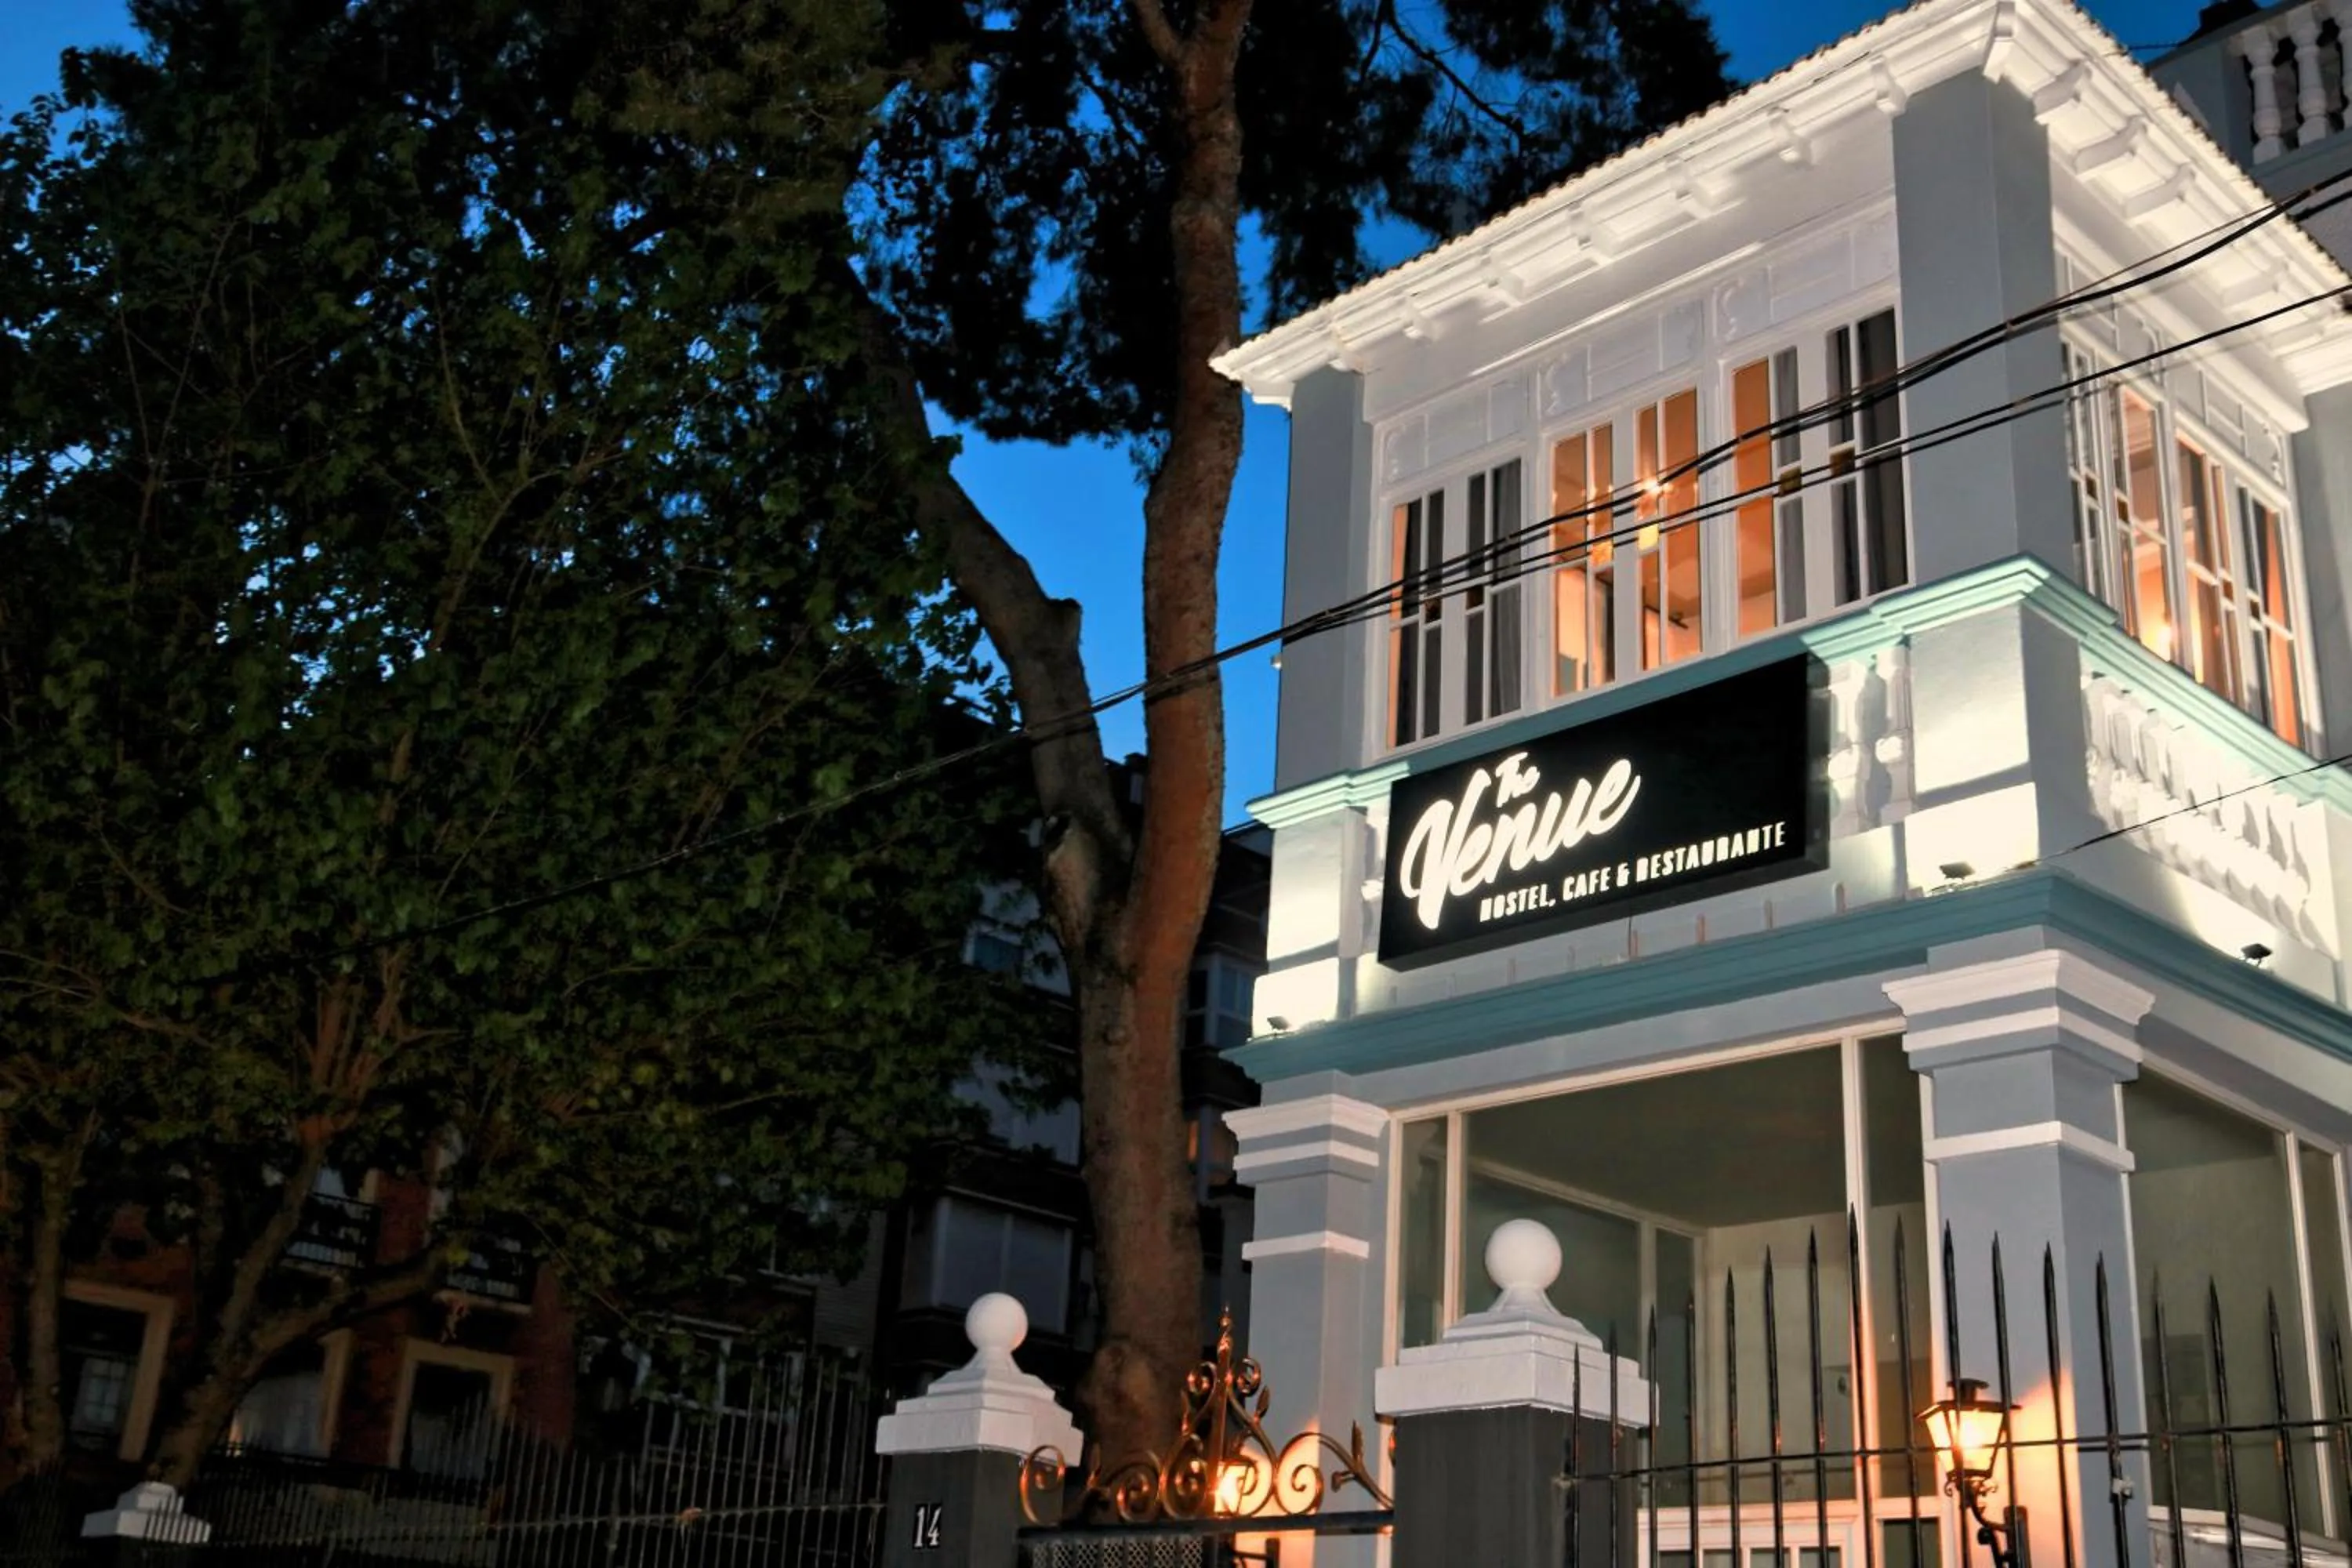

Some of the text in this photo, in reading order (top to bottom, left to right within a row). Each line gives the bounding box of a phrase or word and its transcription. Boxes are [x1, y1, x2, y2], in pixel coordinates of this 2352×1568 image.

[1494, 750, 1541, 808] The
[1399, 757, 1641, 931] Venue
[1563, 867, 1610, 902] CAFE
[1617, 862, 1630, 888] &
[1635, 821, 1787, 884] RESTAURANTE
[913, 1506, 942, 1548] 14
